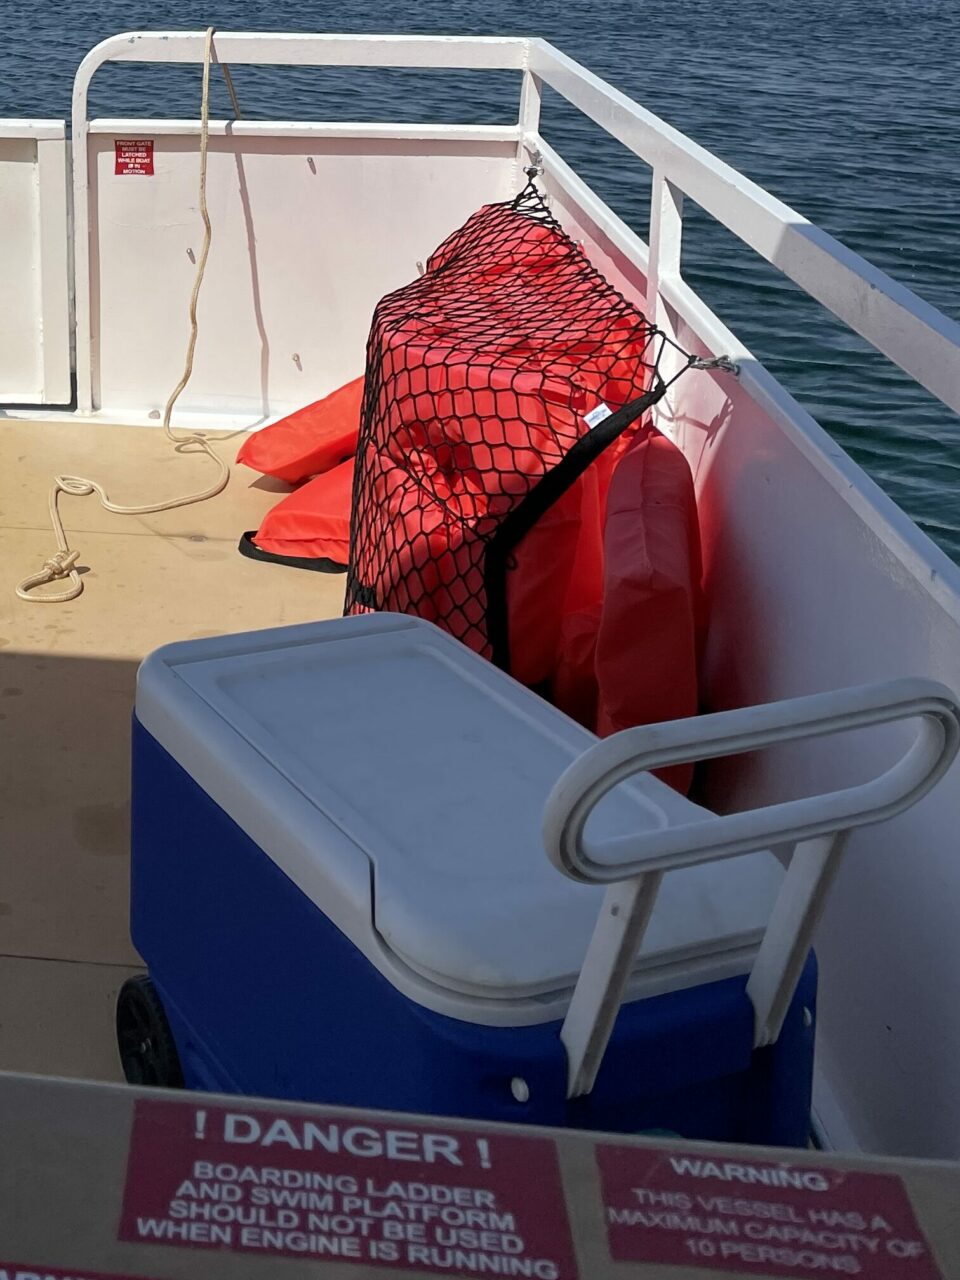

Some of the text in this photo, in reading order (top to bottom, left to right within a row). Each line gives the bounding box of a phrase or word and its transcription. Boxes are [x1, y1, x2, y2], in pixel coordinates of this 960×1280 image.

[223, 1113, 464, 1166] DANGER
[193, 1160, 496, 1209] BOARDING LADDER
[669, 1157, 830, 1193] WARNING
[168, 1198, 525, 1254] SHOULD NOT BE USED
[175, 1180, 515, 1231] AND SWIM PLATFORM
[632, 1187, 892, 1233] THIS VESSEL HAS A
[136, 1217, 559, 1280] WHEN ENGINE IS RUNNING
[607, 1207, 926, 1258] MAXIMUM CAPACITY OF
[688, 1238, 863, 1275] 10 PERSONS
